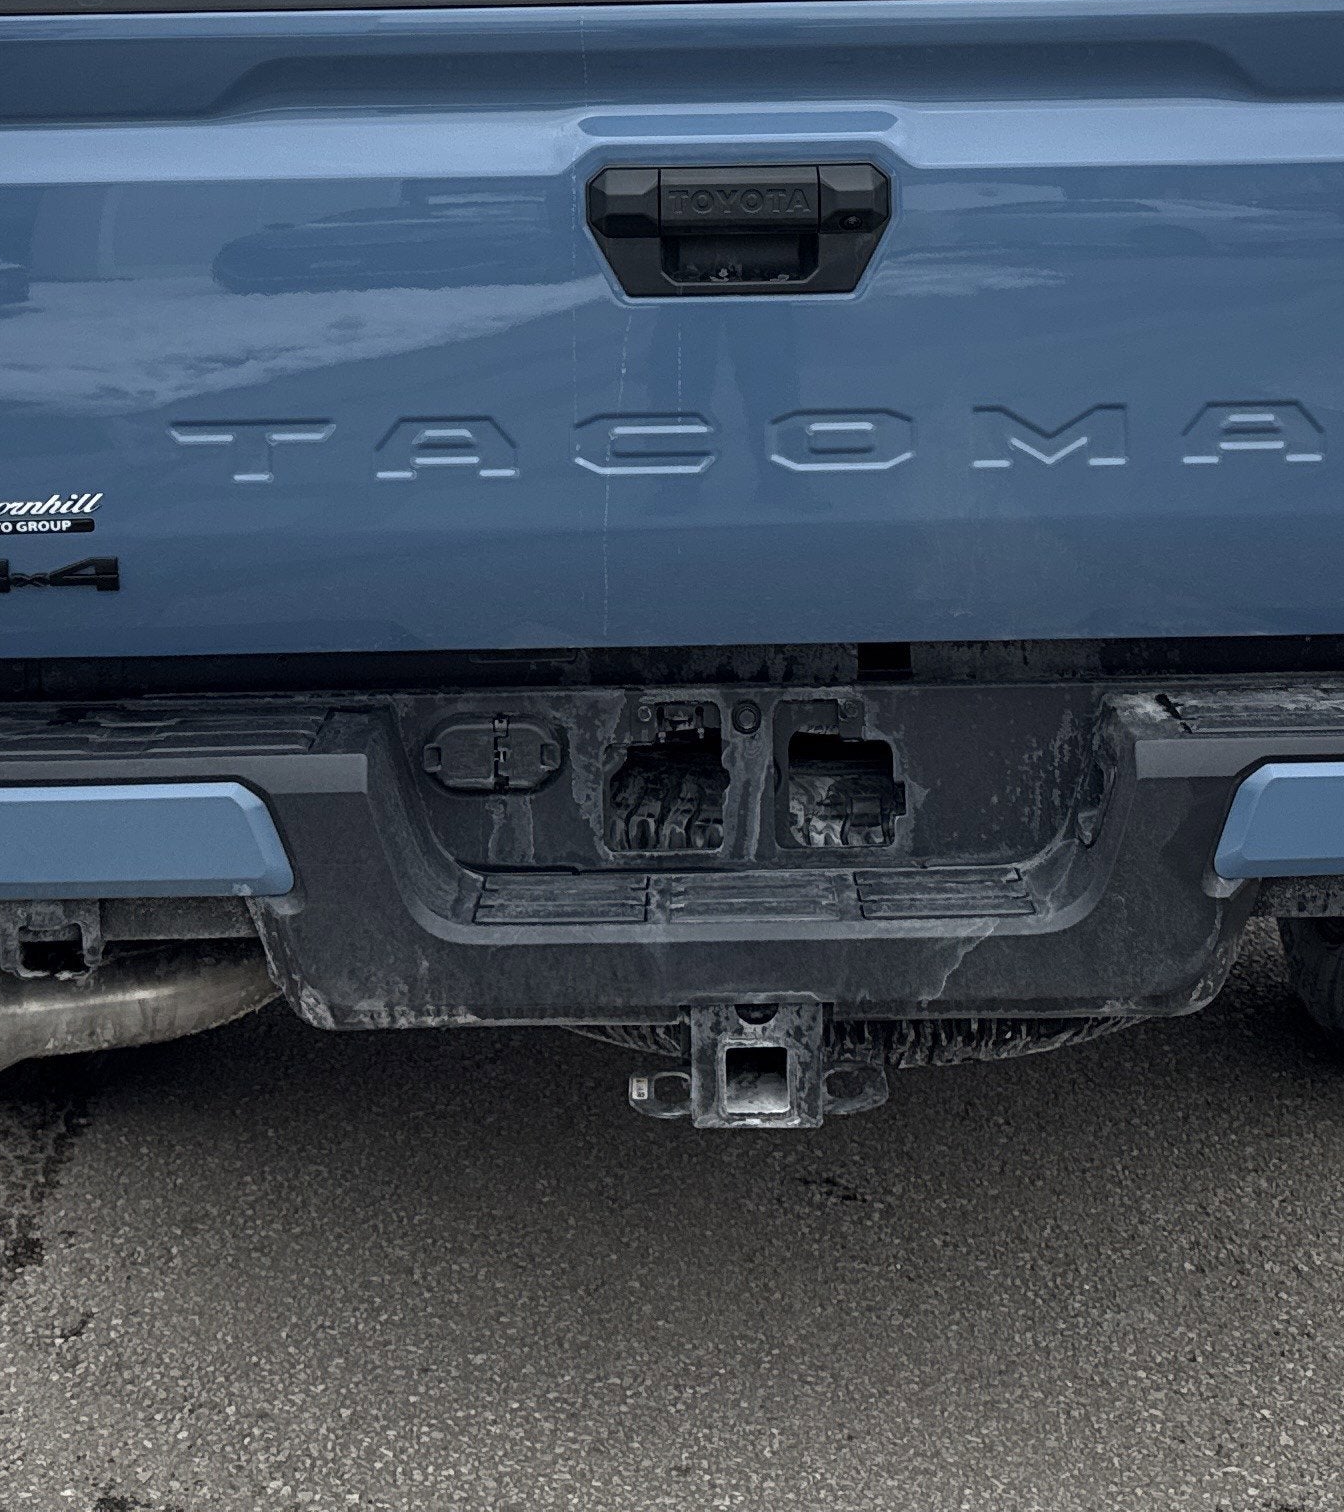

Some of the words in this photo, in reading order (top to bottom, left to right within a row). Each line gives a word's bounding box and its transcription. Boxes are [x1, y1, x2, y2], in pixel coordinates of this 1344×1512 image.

[668, 188, 812, 215] TOYOTA
[169, 400, 1325, 483] TACOMA
[16, 520, 72, 533] GROUP
